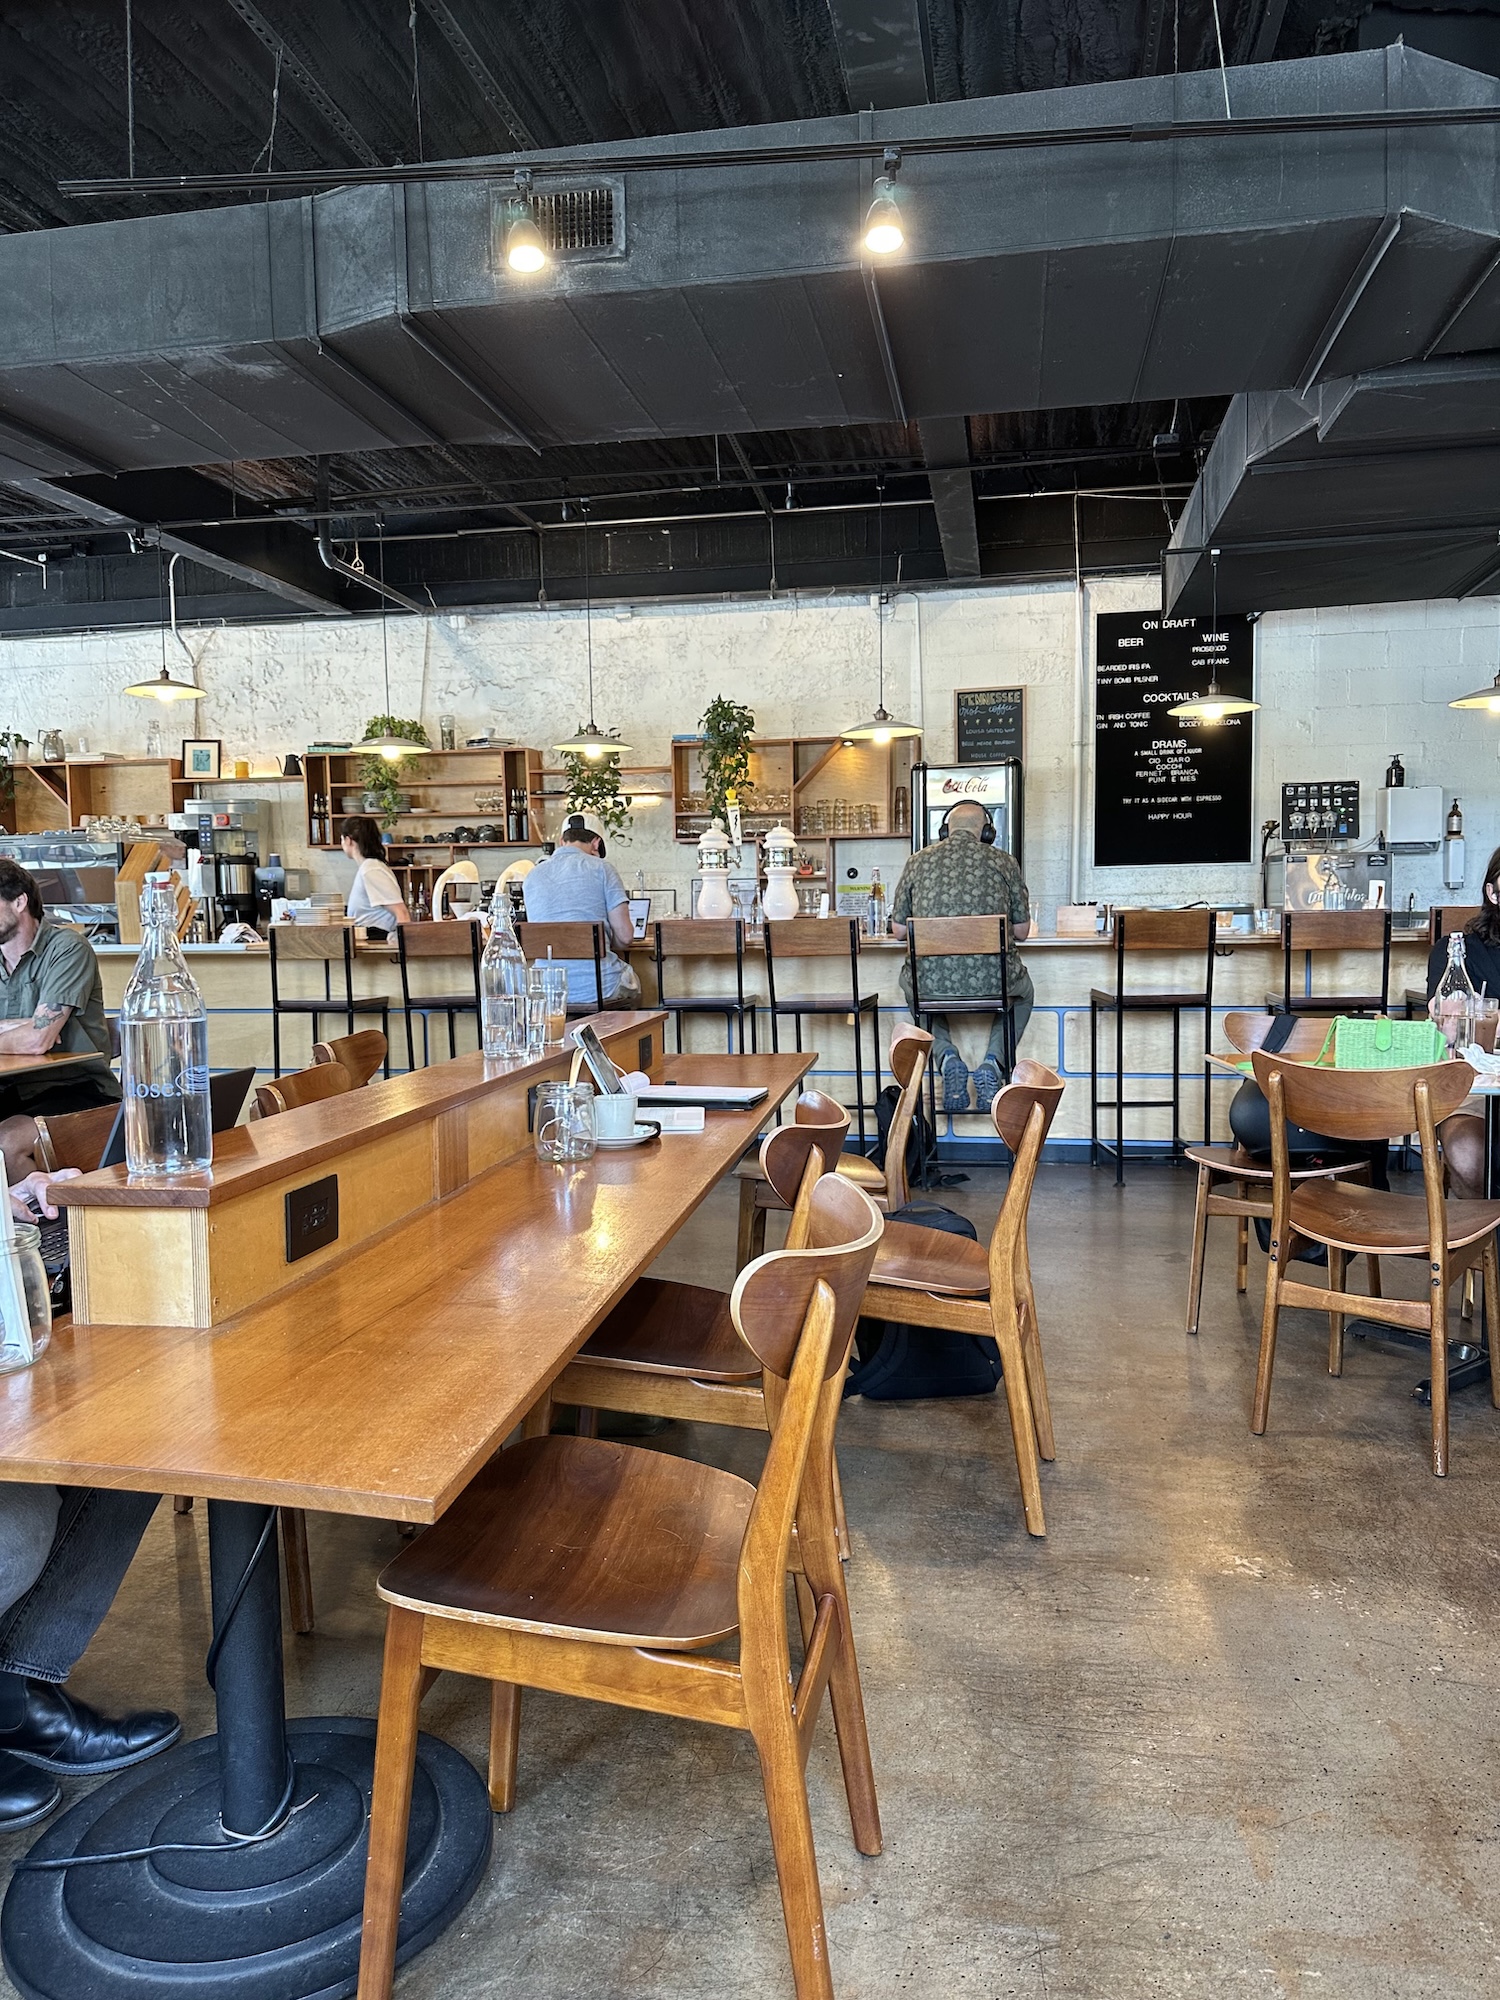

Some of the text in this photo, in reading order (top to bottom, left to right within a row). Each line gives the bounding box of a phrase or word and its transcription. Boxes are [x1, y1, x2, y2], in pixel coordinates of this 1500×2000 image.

[1142, 618, 1197, 630] ON DRAFT
[1117, 637, 1144, 648] BEER
[1201, 632, 1230, 643] WINE
[1191, 658, 1206, 666] CAB
[1097, 664, 1128, 673] BEARDED
[1096, 675, 1159, 685] TINY BOMB PILSNER
[958, 691, 1021, 706] TENNESSEE
[1142, 691, 1200, 703] COCKTAILS
[1107, 713, 1124, 721] IRISH
[1124, 711, 1151, 720] COFFEE
[1096, 720, 1149, 730] GIN AND TONIC
[1178, 720, 1201, 728] BOOZY
[1151, 739, 1188, 750] DRAMS
[1140, 749, 1159, 757] SMALL
[1183, 747, 1203, 755] LIQUOR
[1155, 763, 1183, 771] COCCHI
[1135, 768, 1199, 778] FERNET BRANCA
[1148, 776, 1167, 784] PUNT
[1122, 797, 1132, 805] TRY
[1195, 794, 1222, 802] ESPRESSO
[1148, 812, 1193, 821] HAPPY HOUR
